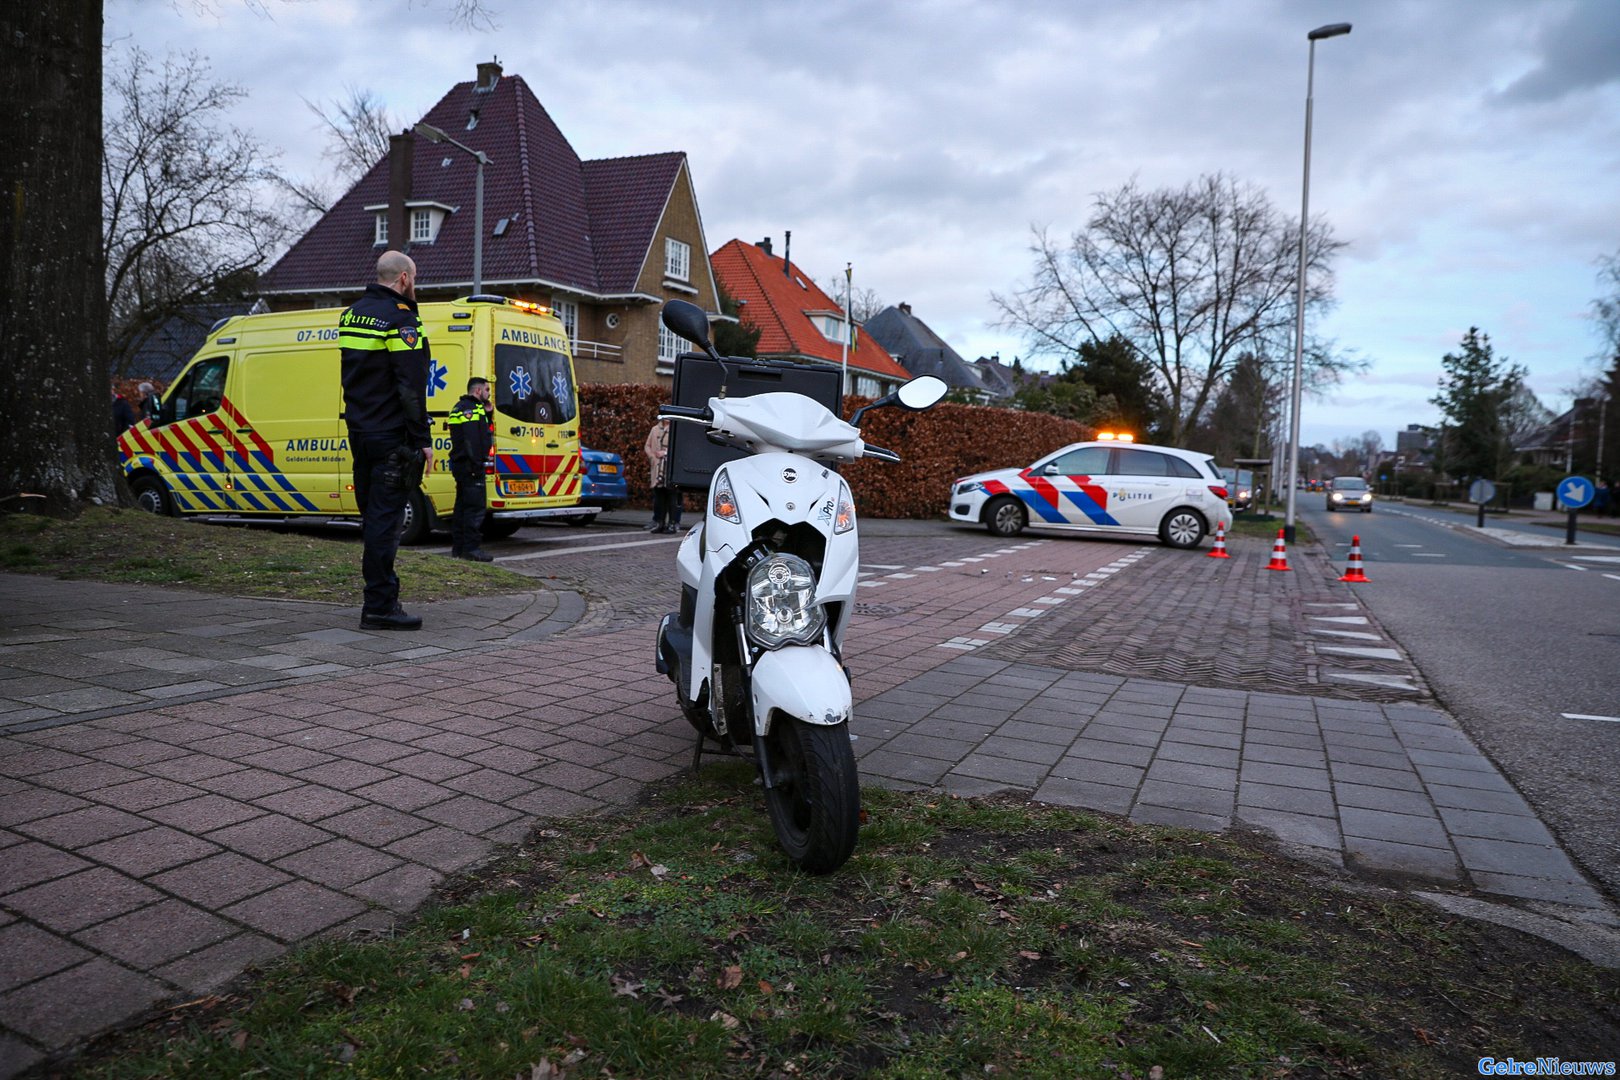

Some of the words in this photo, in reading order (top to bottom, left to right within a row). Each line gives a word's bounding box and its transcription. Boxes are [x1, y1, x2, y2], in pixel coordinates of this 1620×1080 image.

[297, 329, 338, 342] 07-106
[501, 328, 567, 352] AMBULANCE
[286, 439, 349, 452] AMBULA
[1112, 488, 1152, 501] POLITIE
